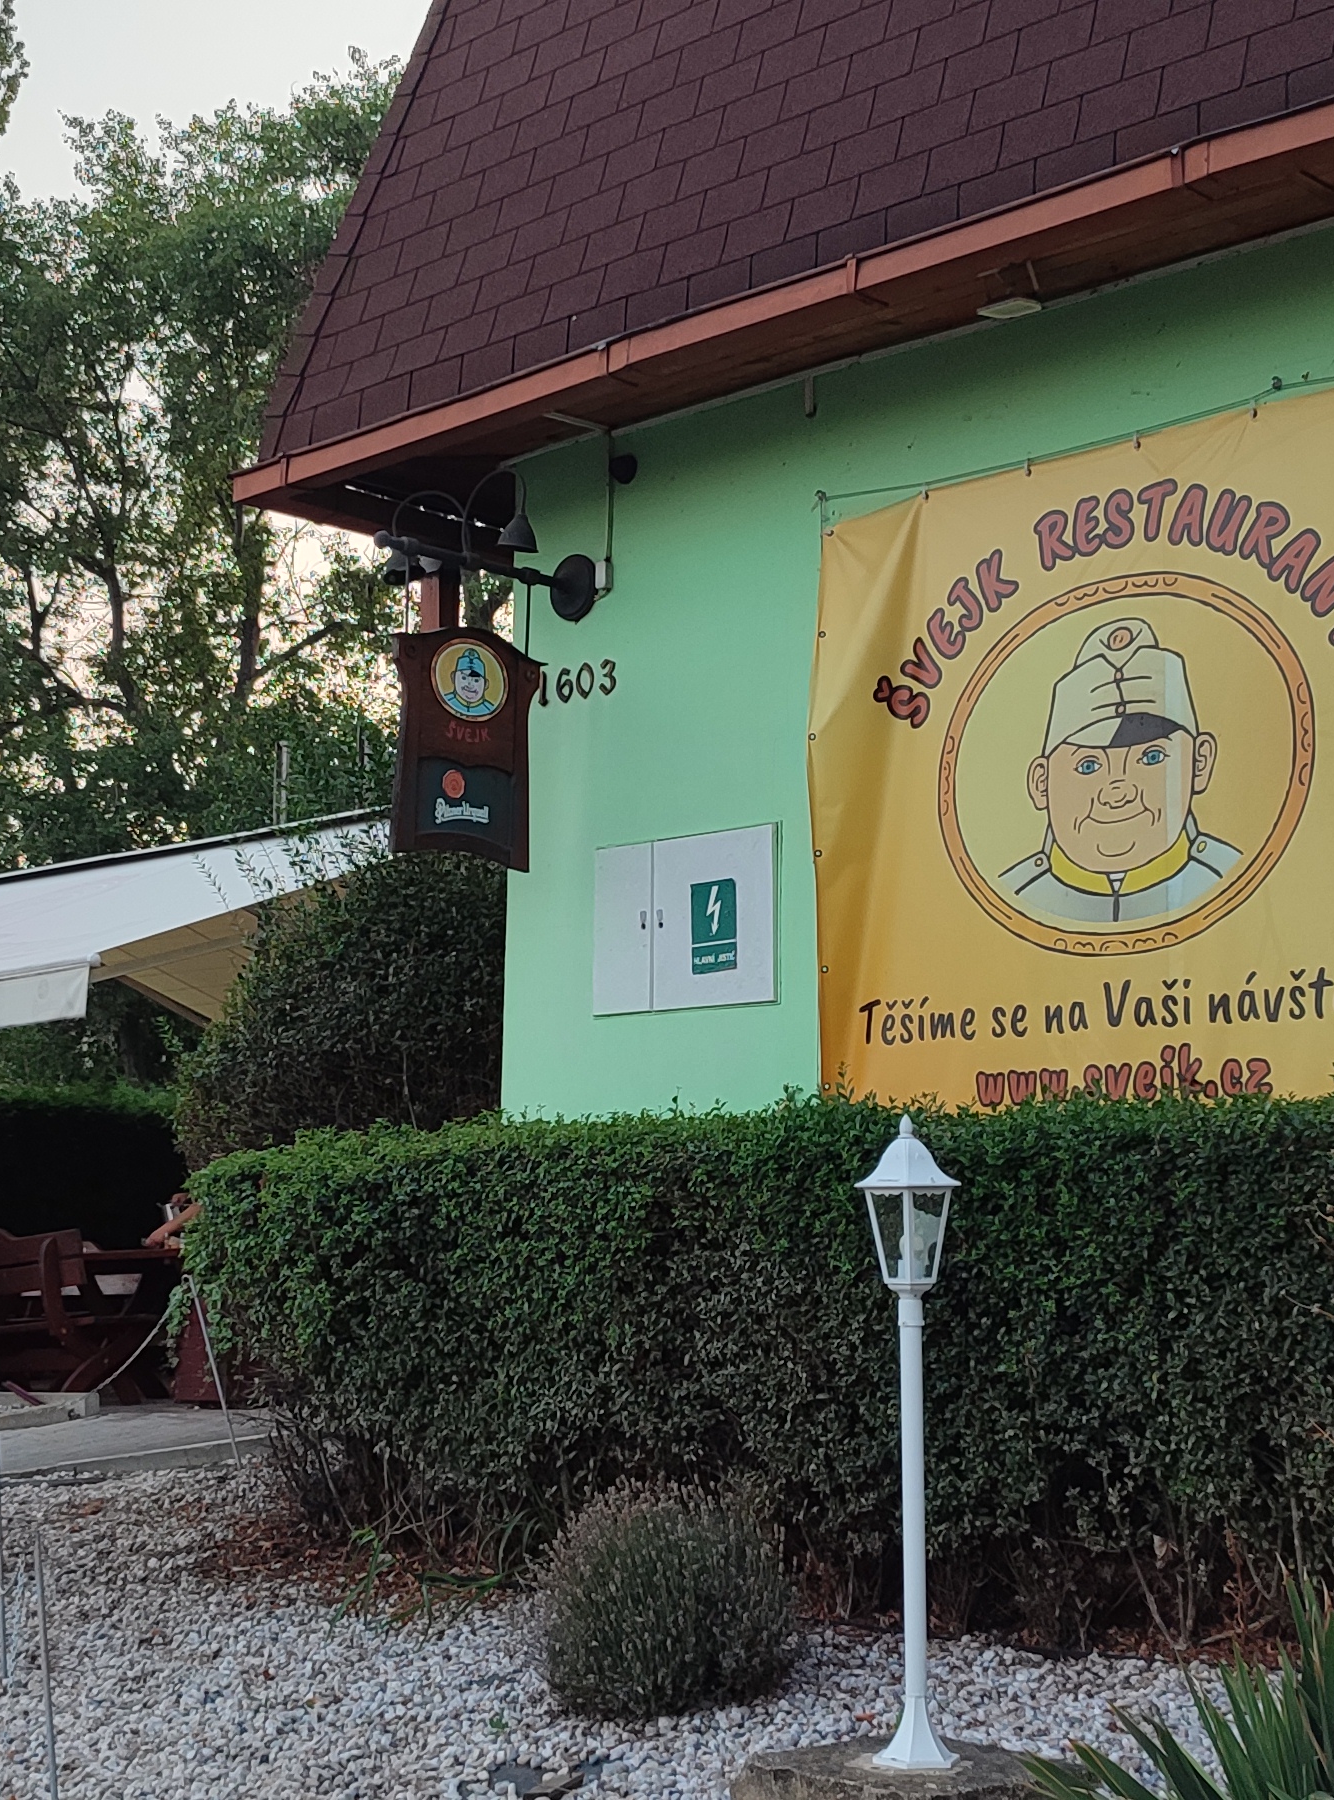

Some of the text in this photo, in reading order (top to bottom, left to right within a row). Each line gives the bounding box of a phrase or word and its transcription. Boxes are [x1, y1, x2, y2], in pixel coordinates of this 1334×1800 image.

[873, 549, 1020, 728] ŠVEJK
[538, 658, 617, 707] 1603
[445, 720, 491, 743] ŠVEJK
[858, 996, 977, 1046] Těšíme
[990, 1006, 1029, 1038] se
[1044, 1000, 1089, 1035] na
[1103, 977, 1192, 1029] Vaši
